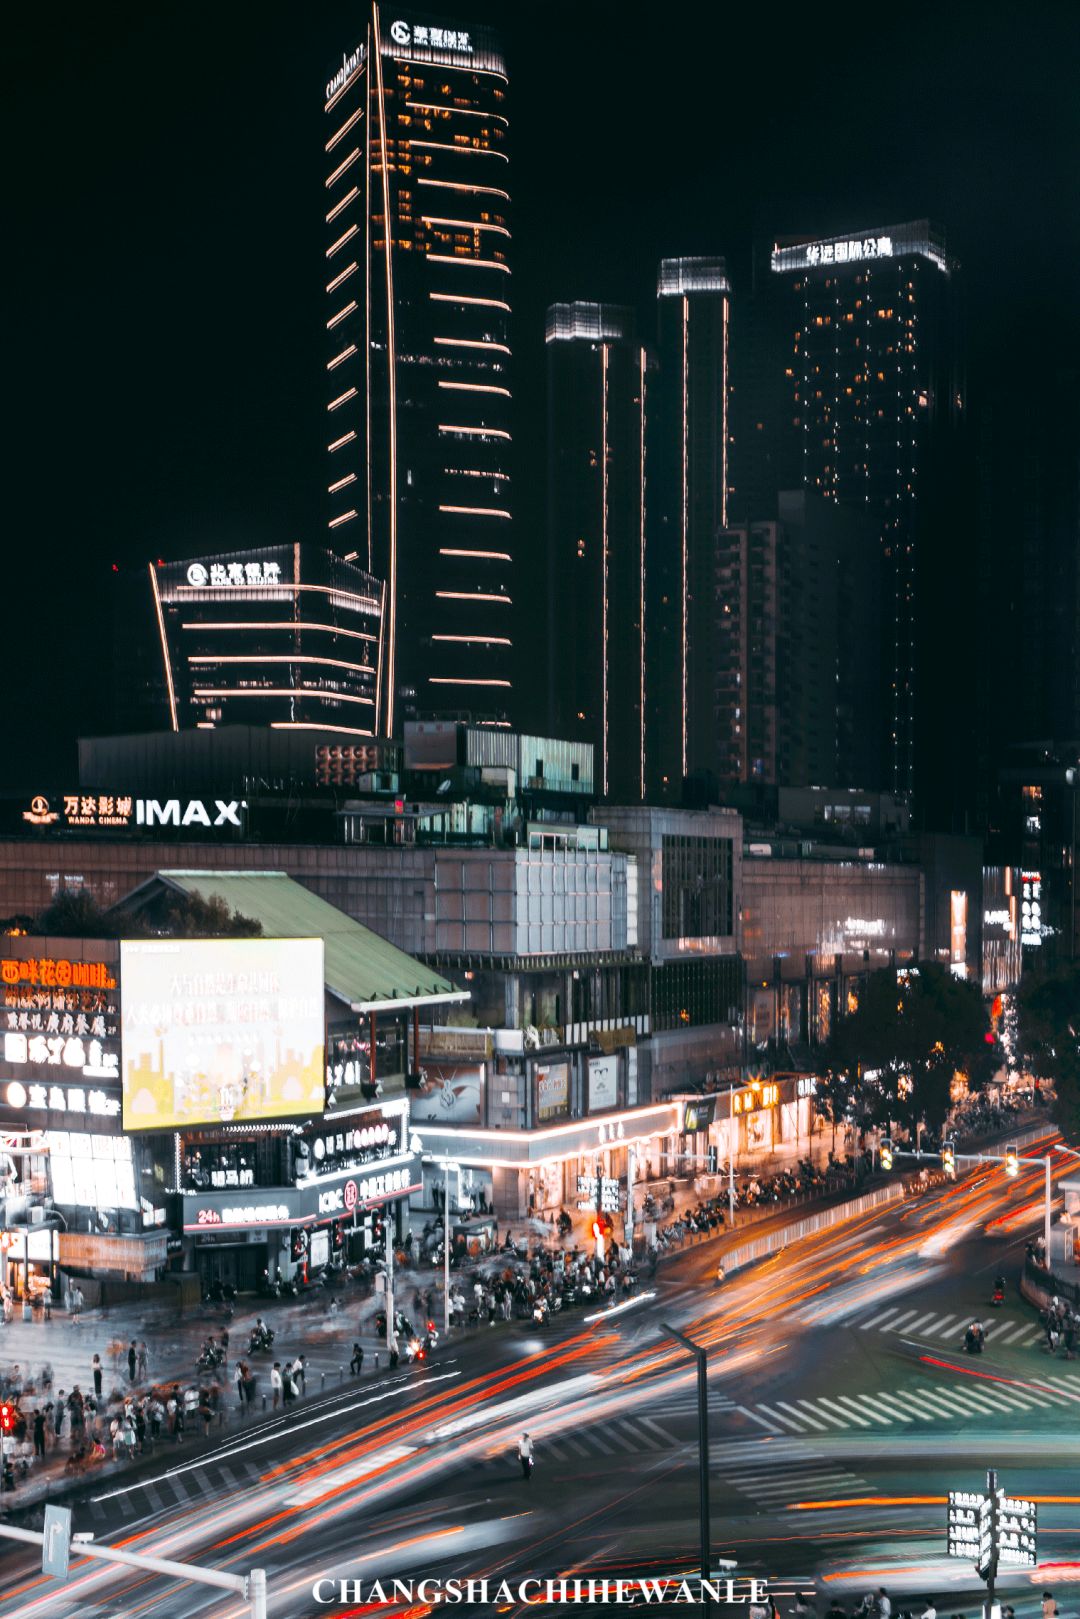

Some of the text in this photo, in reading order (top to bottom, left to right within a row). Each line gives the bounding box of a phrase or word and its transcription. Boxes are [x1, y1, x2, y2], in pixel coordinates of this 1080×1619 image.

[64, 796, 131, 816] 万达影城
[136, 799, 241, 827] IMAX
[68, 816, 128, 825] WANDA CINEMA
[199, 1210, 220, 1224] 24h
